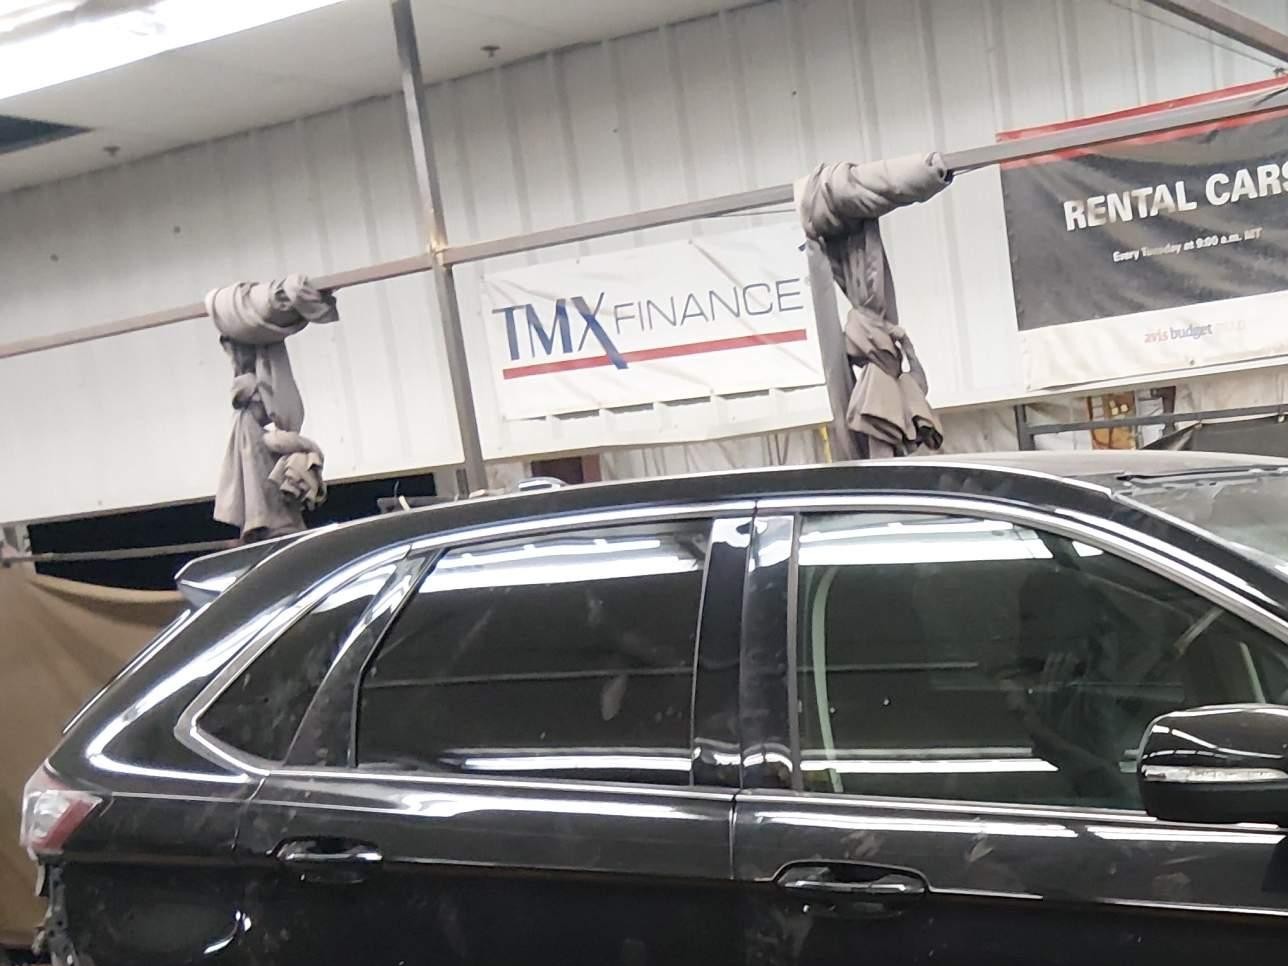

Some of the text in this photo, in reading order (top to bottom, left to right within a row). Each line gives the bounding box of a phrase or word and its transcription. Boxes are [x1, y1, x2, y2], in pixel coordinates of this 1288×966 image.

[1063, 180, 1197, 232] RENTAL
[1183, 240, 1195, 251] at
[492, 278, 805, 370] TMX FINANCE
[1144, 330, 1169, 343] avis
[1169, 323, 1213, 340] budget
